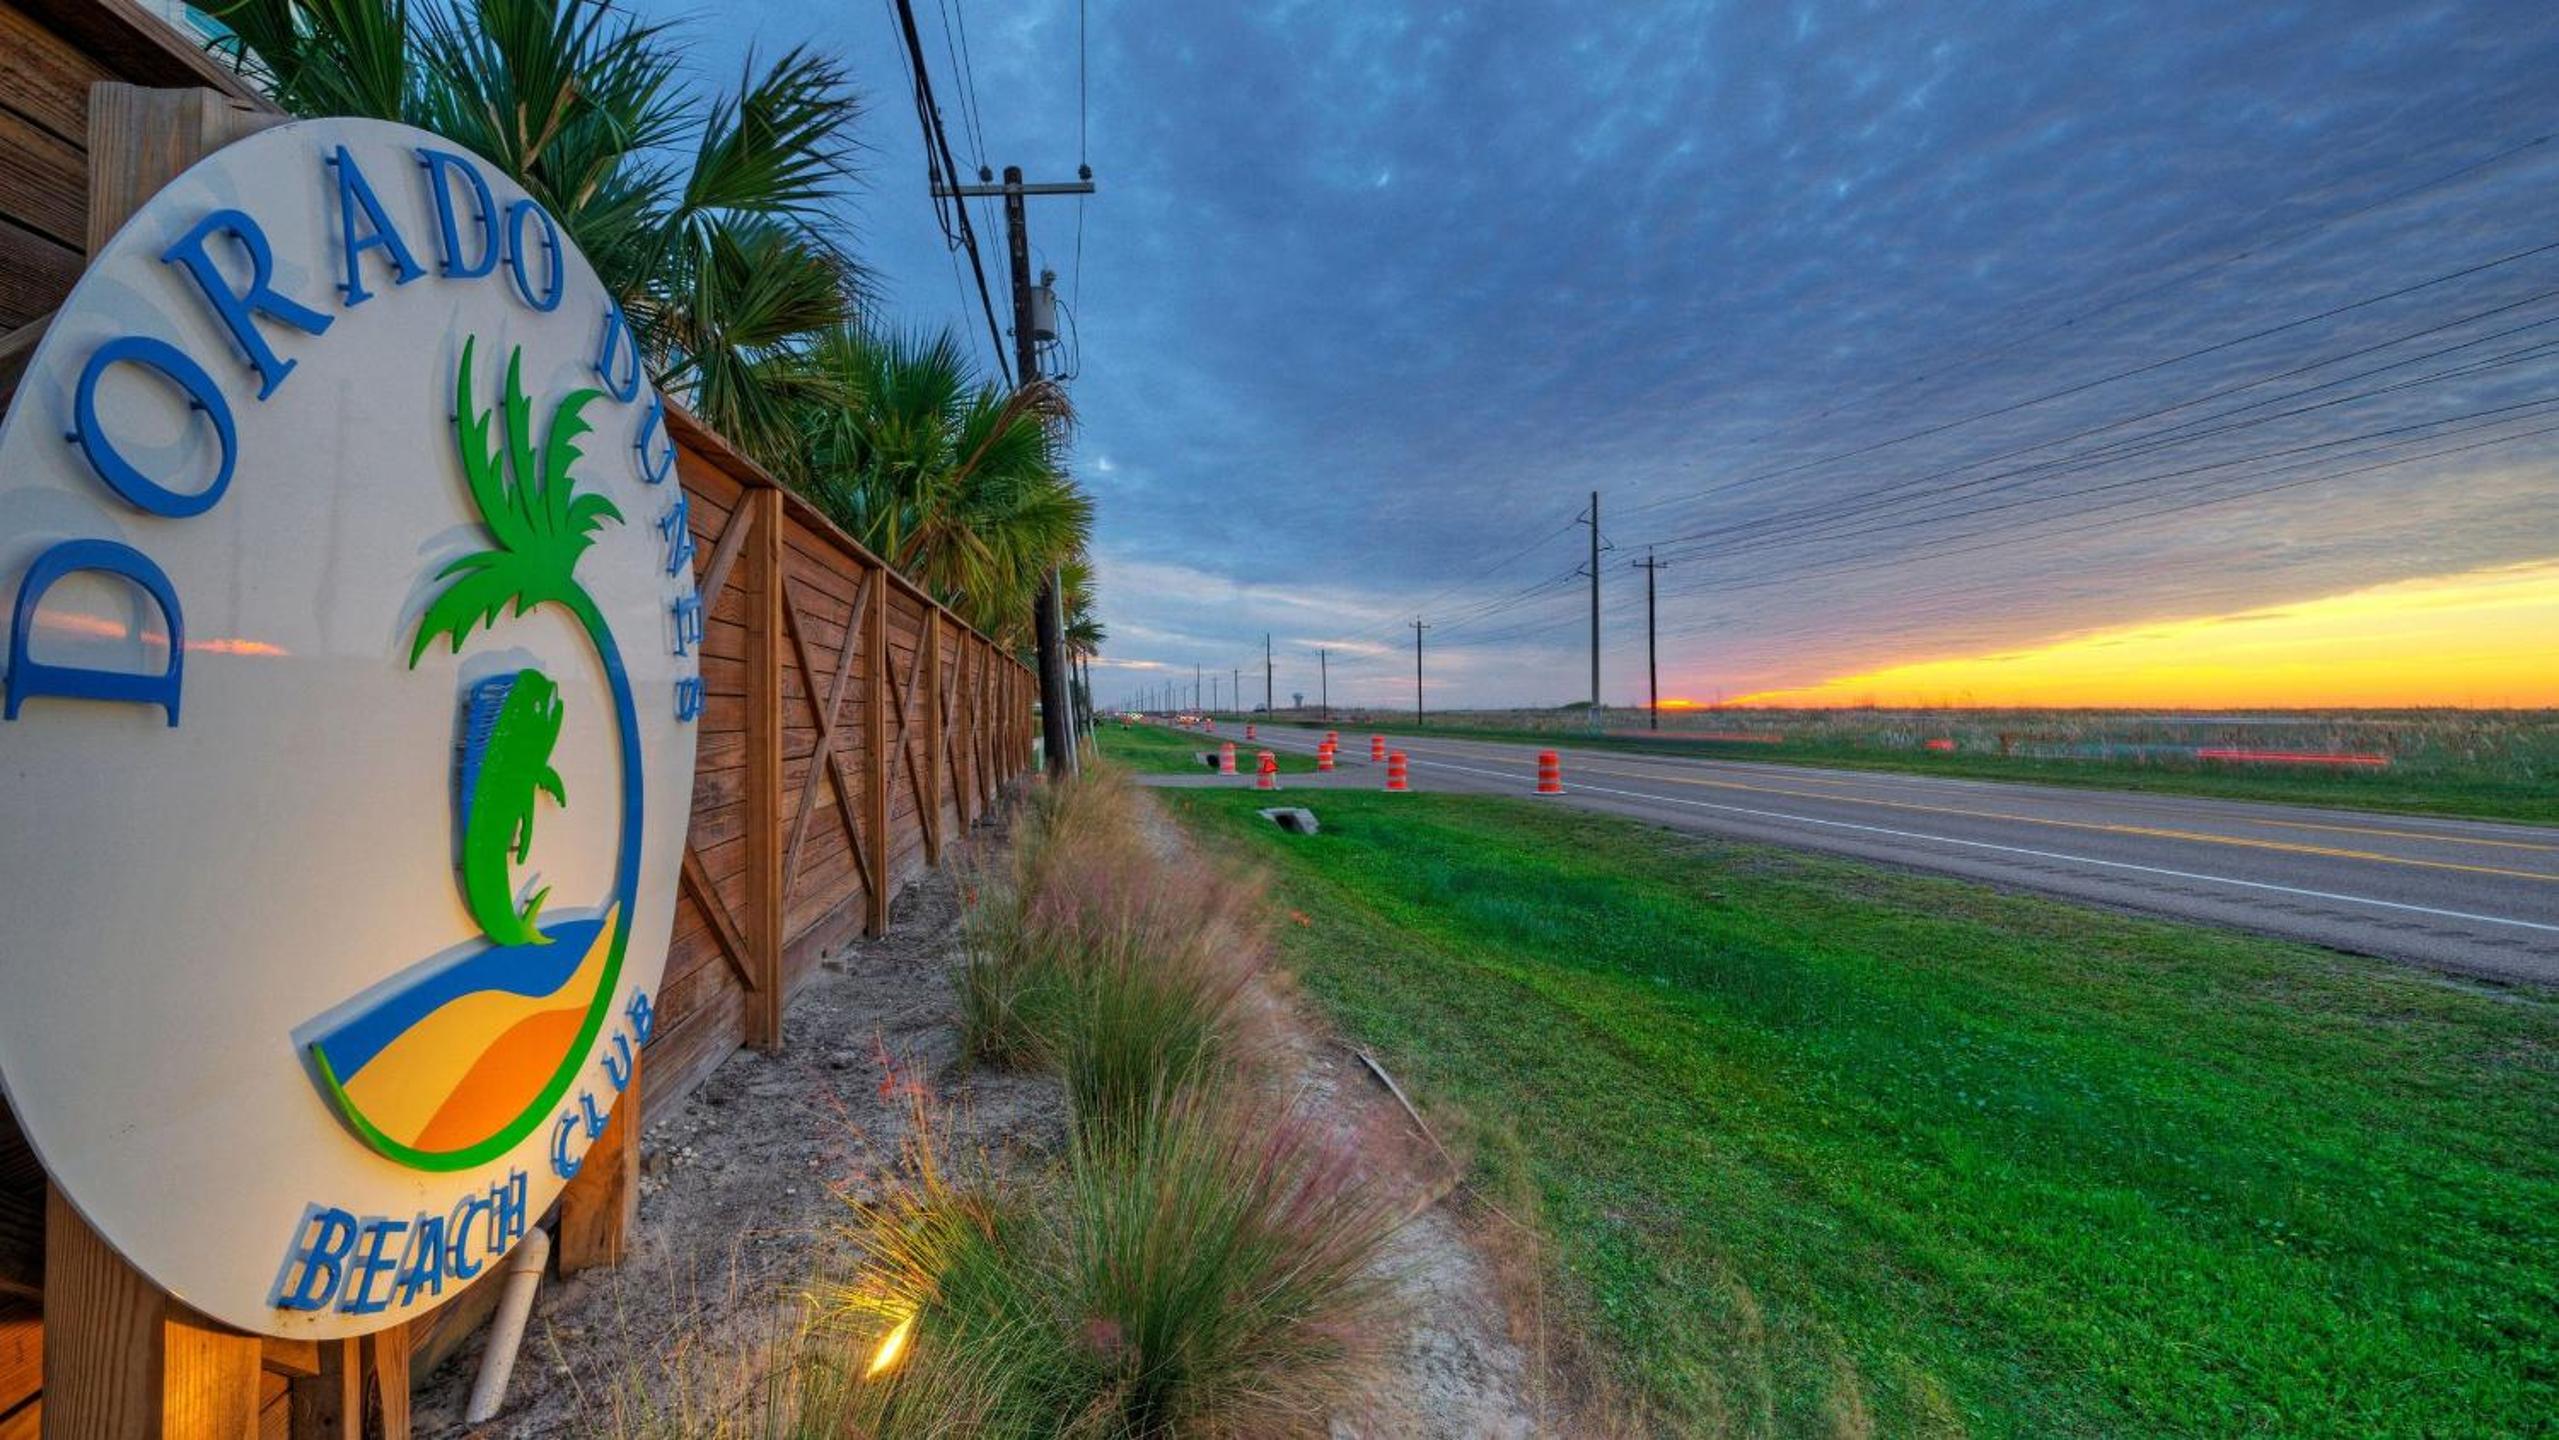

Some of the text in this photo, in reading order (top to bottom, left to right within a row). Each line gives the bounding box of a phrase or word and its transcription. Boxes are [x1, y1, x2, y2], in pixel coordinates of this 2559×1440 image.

[4, 145, 705, 728] DORADO DUNES
[276, 990, 654, 1316] BEACH CLUB
